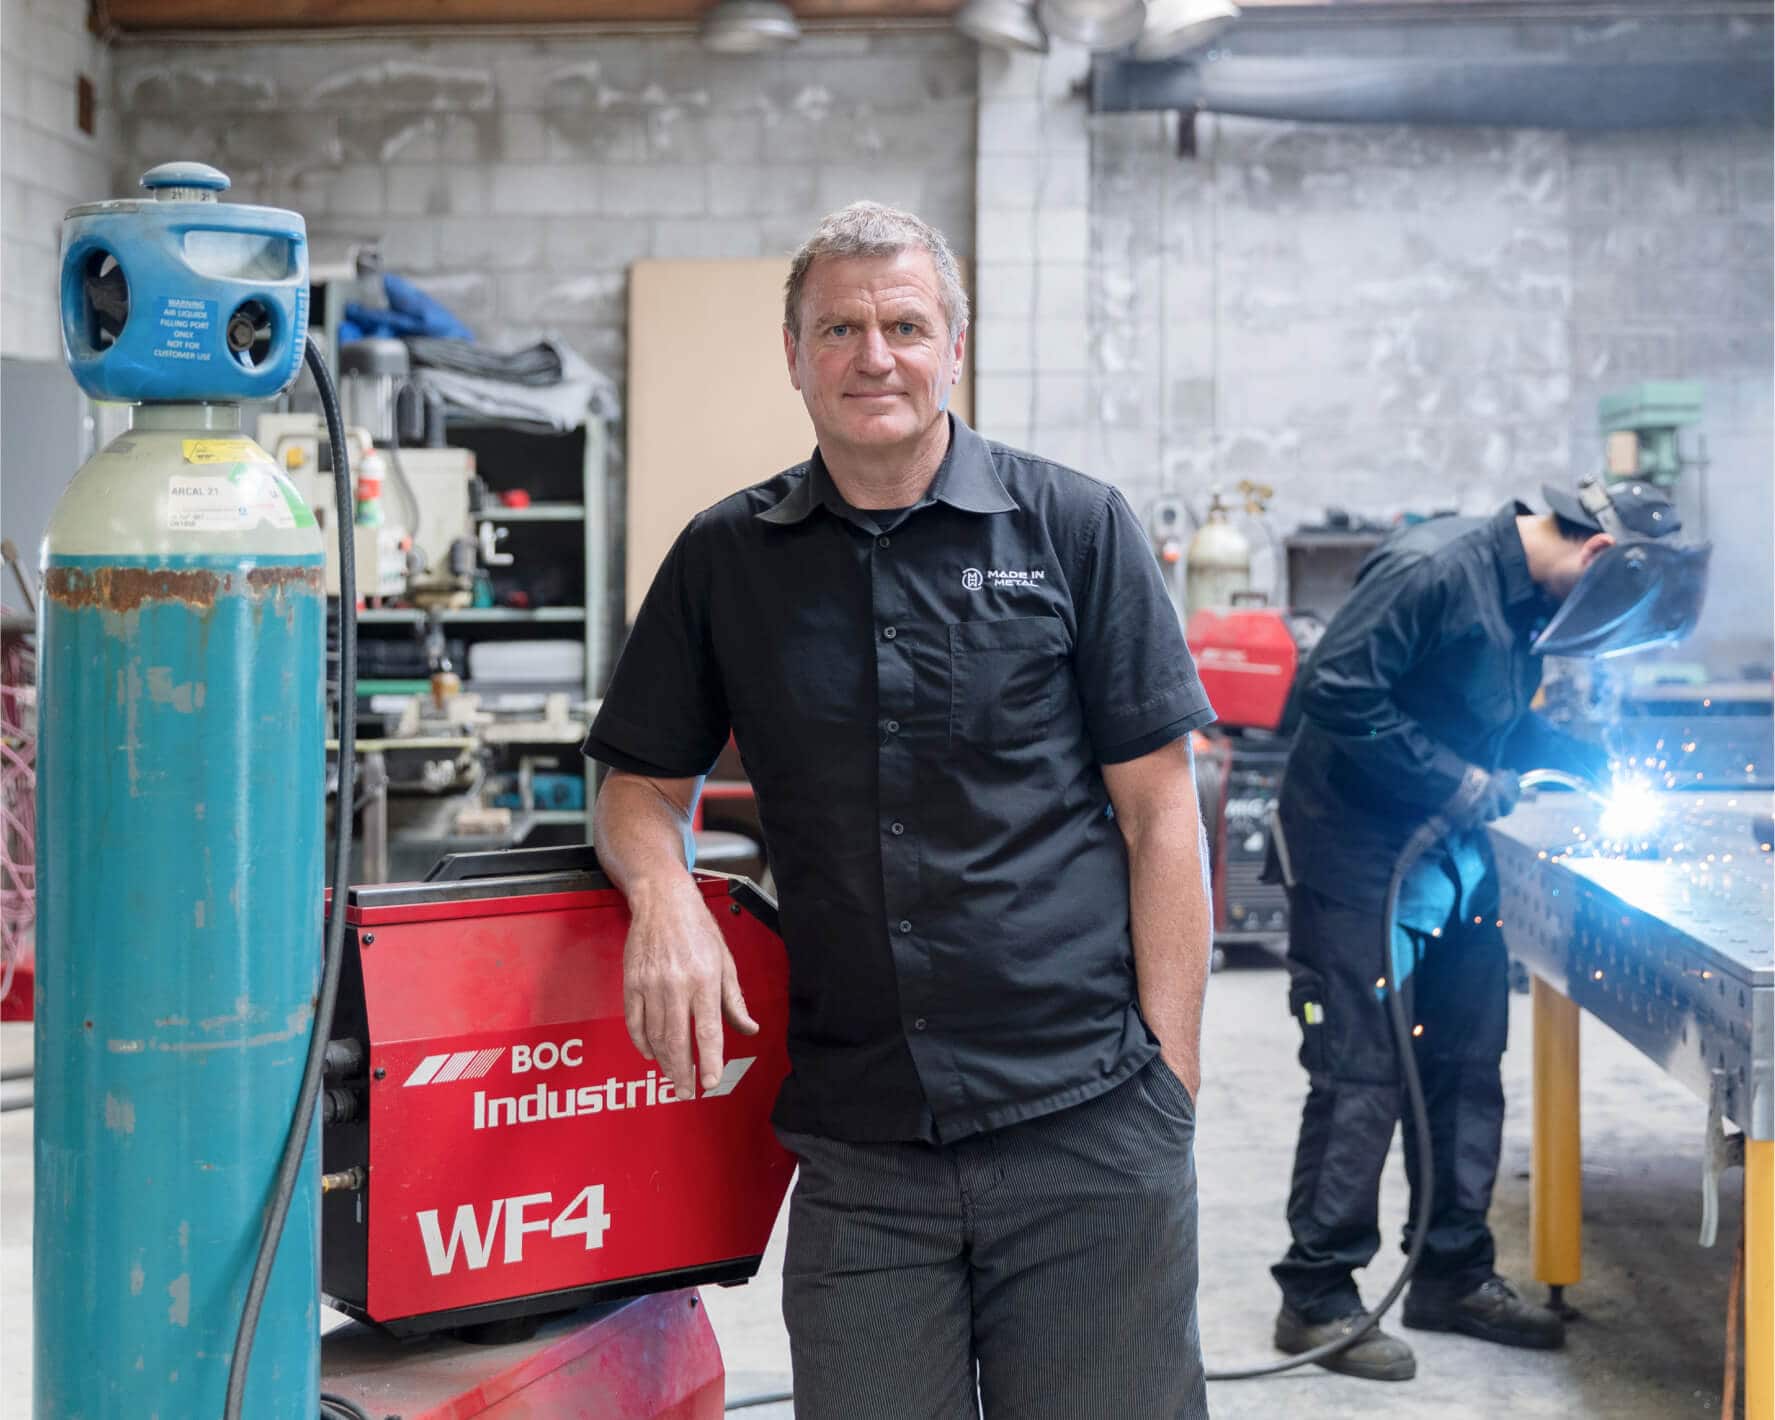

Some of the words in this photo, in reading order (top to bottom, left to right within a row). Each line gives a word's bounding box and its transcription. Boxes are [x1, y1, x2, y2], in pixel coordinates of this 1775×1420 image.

[168, 299, 205, 309] WARNING
[160, 318, 188, 328] FILLING
[190, 321, 209, 329] PORT
[167, 340, 183, 348] NOT
[185, 341, 200, 349] FOR
[153, 349, 196, 359] CUSTOMER
[197, 352, 211, 360] USE
[171, 487, 205, 496] ARCAL
[207, 487, 219, 496] 21
[987, 570, 1028, 579] MADE
[1031, 570, 1045, 579] IN
[994, 579, 1038, 587] METAL
[511, 1038, 584, 1074] BOC
[416, 1184, 612, 1277] WF4
